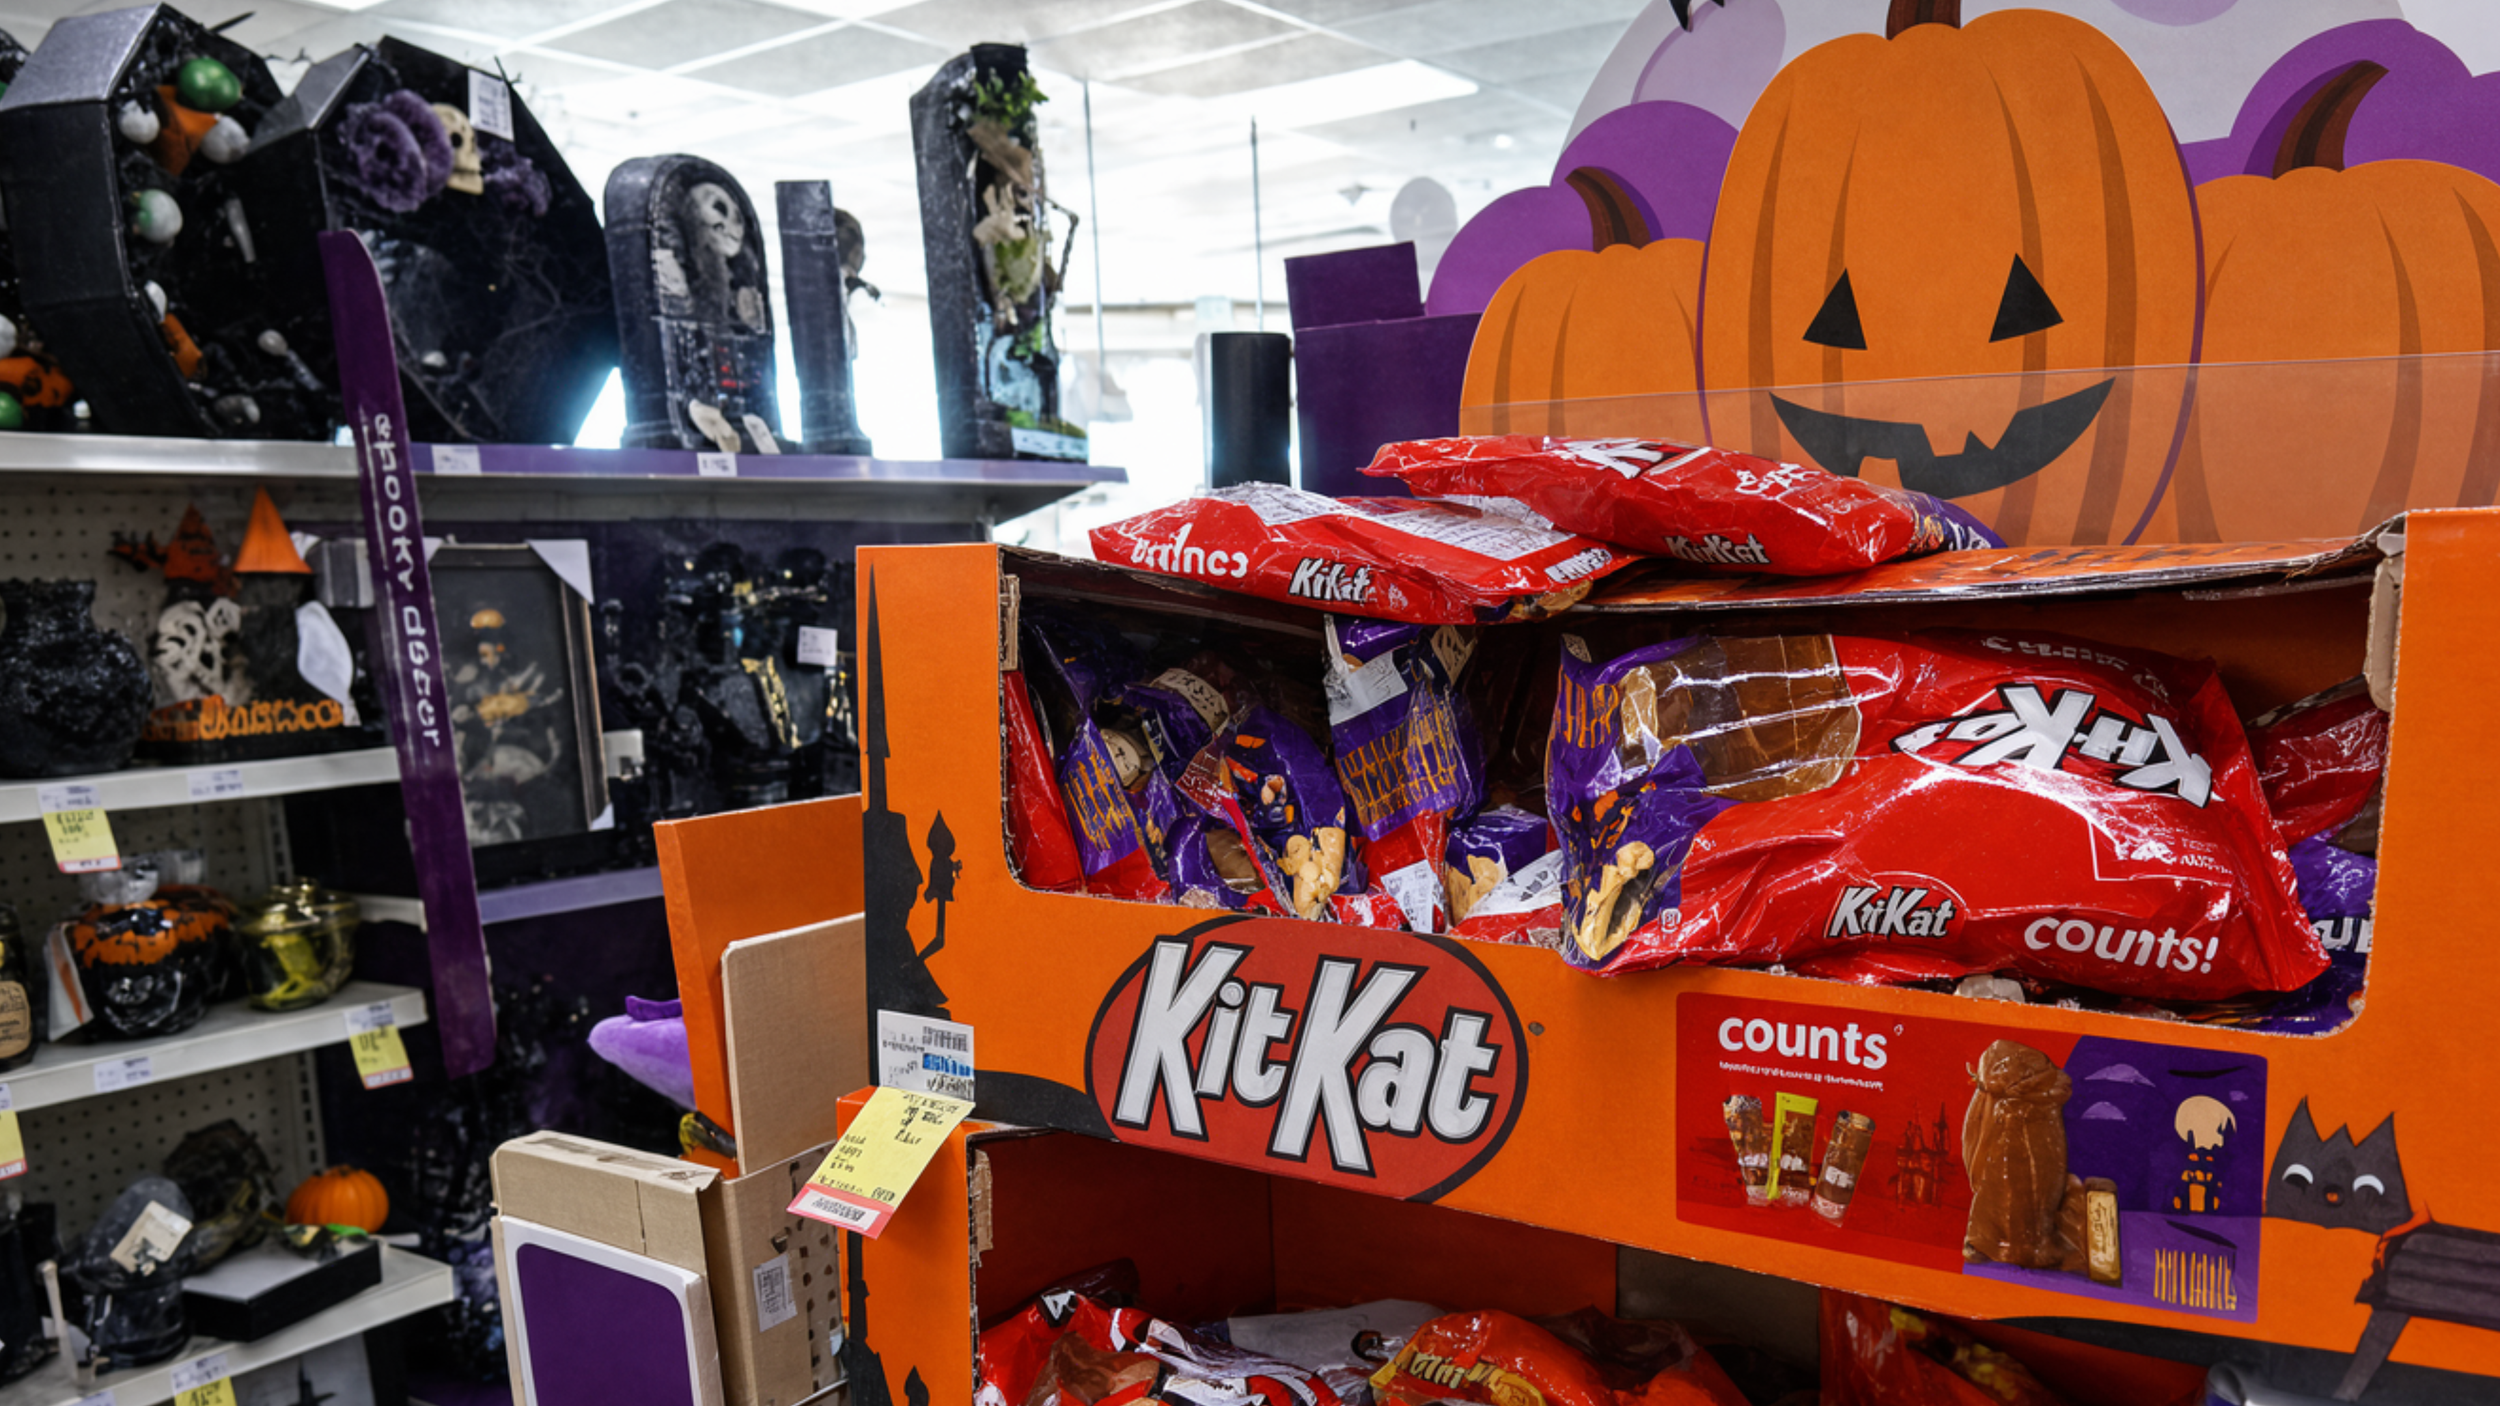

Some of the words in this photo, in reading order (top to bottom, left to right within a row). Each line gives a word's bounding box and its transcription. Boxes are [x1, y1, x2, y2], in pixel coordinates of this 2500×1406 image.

[2023, 916, 2220, 974] counts!
[1112, 934, 1503, 1179] KitKat
[1718, 1016, 1888, 1070] counts
